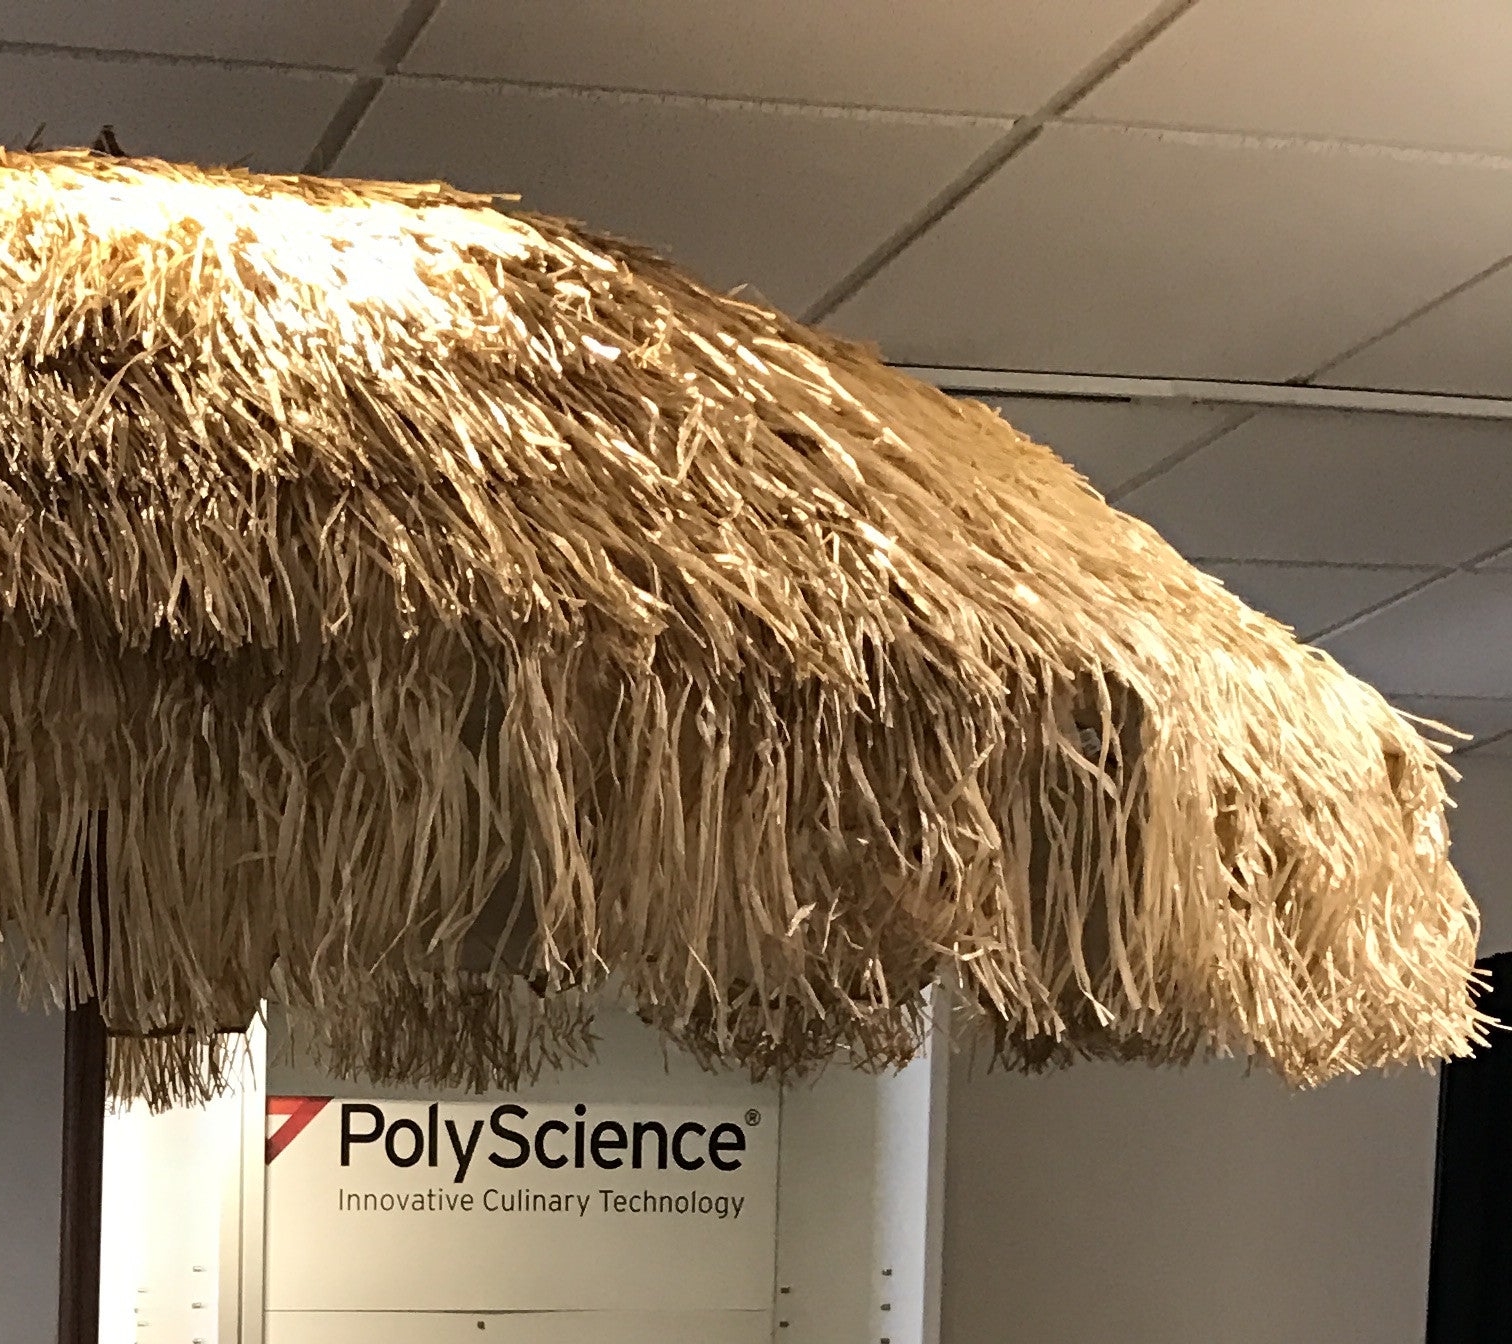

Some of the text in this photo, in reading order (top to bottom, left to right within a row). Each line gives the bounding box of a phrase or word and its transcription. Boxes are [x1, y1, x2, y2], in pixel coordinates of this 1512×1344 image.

[338, 1188, 745, 1219] Innovative Culinary Technology
